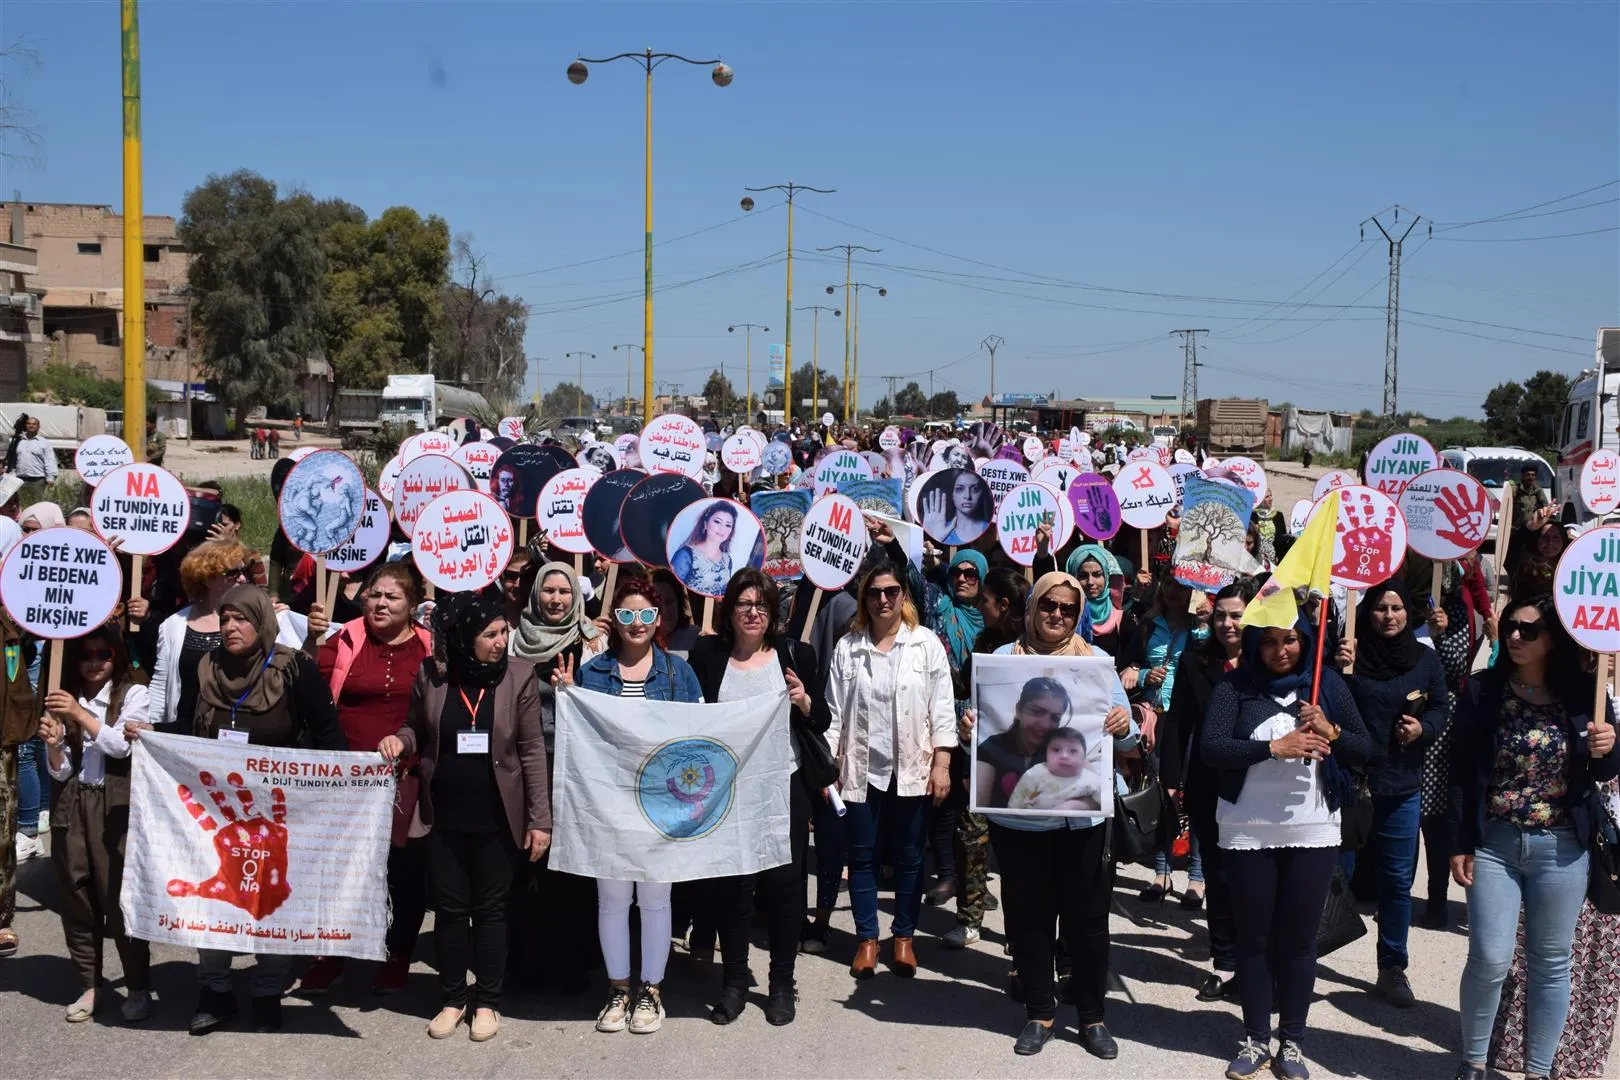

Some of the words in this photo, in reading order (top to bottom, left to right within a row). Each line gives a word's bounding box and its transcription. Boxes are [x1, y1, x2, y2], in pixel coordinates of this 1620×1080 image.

[684, 424, 695, 435] لن
[652, 447, 670, 460] فيه
[670, 451, 691, 463] تقتل
[1591, 457, 1617, 473] ارفع
[126, 471, 160, 498] NA
[1009, 471, 1028, 483] XWE
[990, 481, 1018, 492] BEDEN
[1433, 484, 1440, 493] لا
[443, 501, 483, 524] الصمت
[547, 500, 575, 518] تقتل
[1406, 504, 1435, 516] STOP
[102, 516, 127, 531] SER
[162, 520, 178, 534] RE
[828, 501, 853, 536] NA
[418, 527, 458, 559] مشاركة
[461, 524, 490, 552] القتل
[493, 526, 509, 549] عن
[20, 543, 70, 562] DESTÊ
[73, 547, 107, 565] XWE
[1353, 544, 1380, 555] STOP
[438, 552, 483, 580] الجريمة
[485, 548, 498, 580] في
[804, 541, 823, 561] SER
[841, 558, 855, 576] RE
[38, 565, 99, 586] BEDENA
[1357, 567, 1371, 577] NA
[246, 757, 343, 777] RÊXISTINA
[262, 776, 269, 785] A
[231, 847, 271, 860] STOP
[240, 880, 260, 893] NA
[158, 914, 185, 931] المرأة
[187, 919, 207, 933] ضد
[208, 920, 243, 935] العنف
[245, 922, 288, 940] لمناهضة
[290, 928, 315, 942] سارا
[317, 927, 352, 941] منظمة
